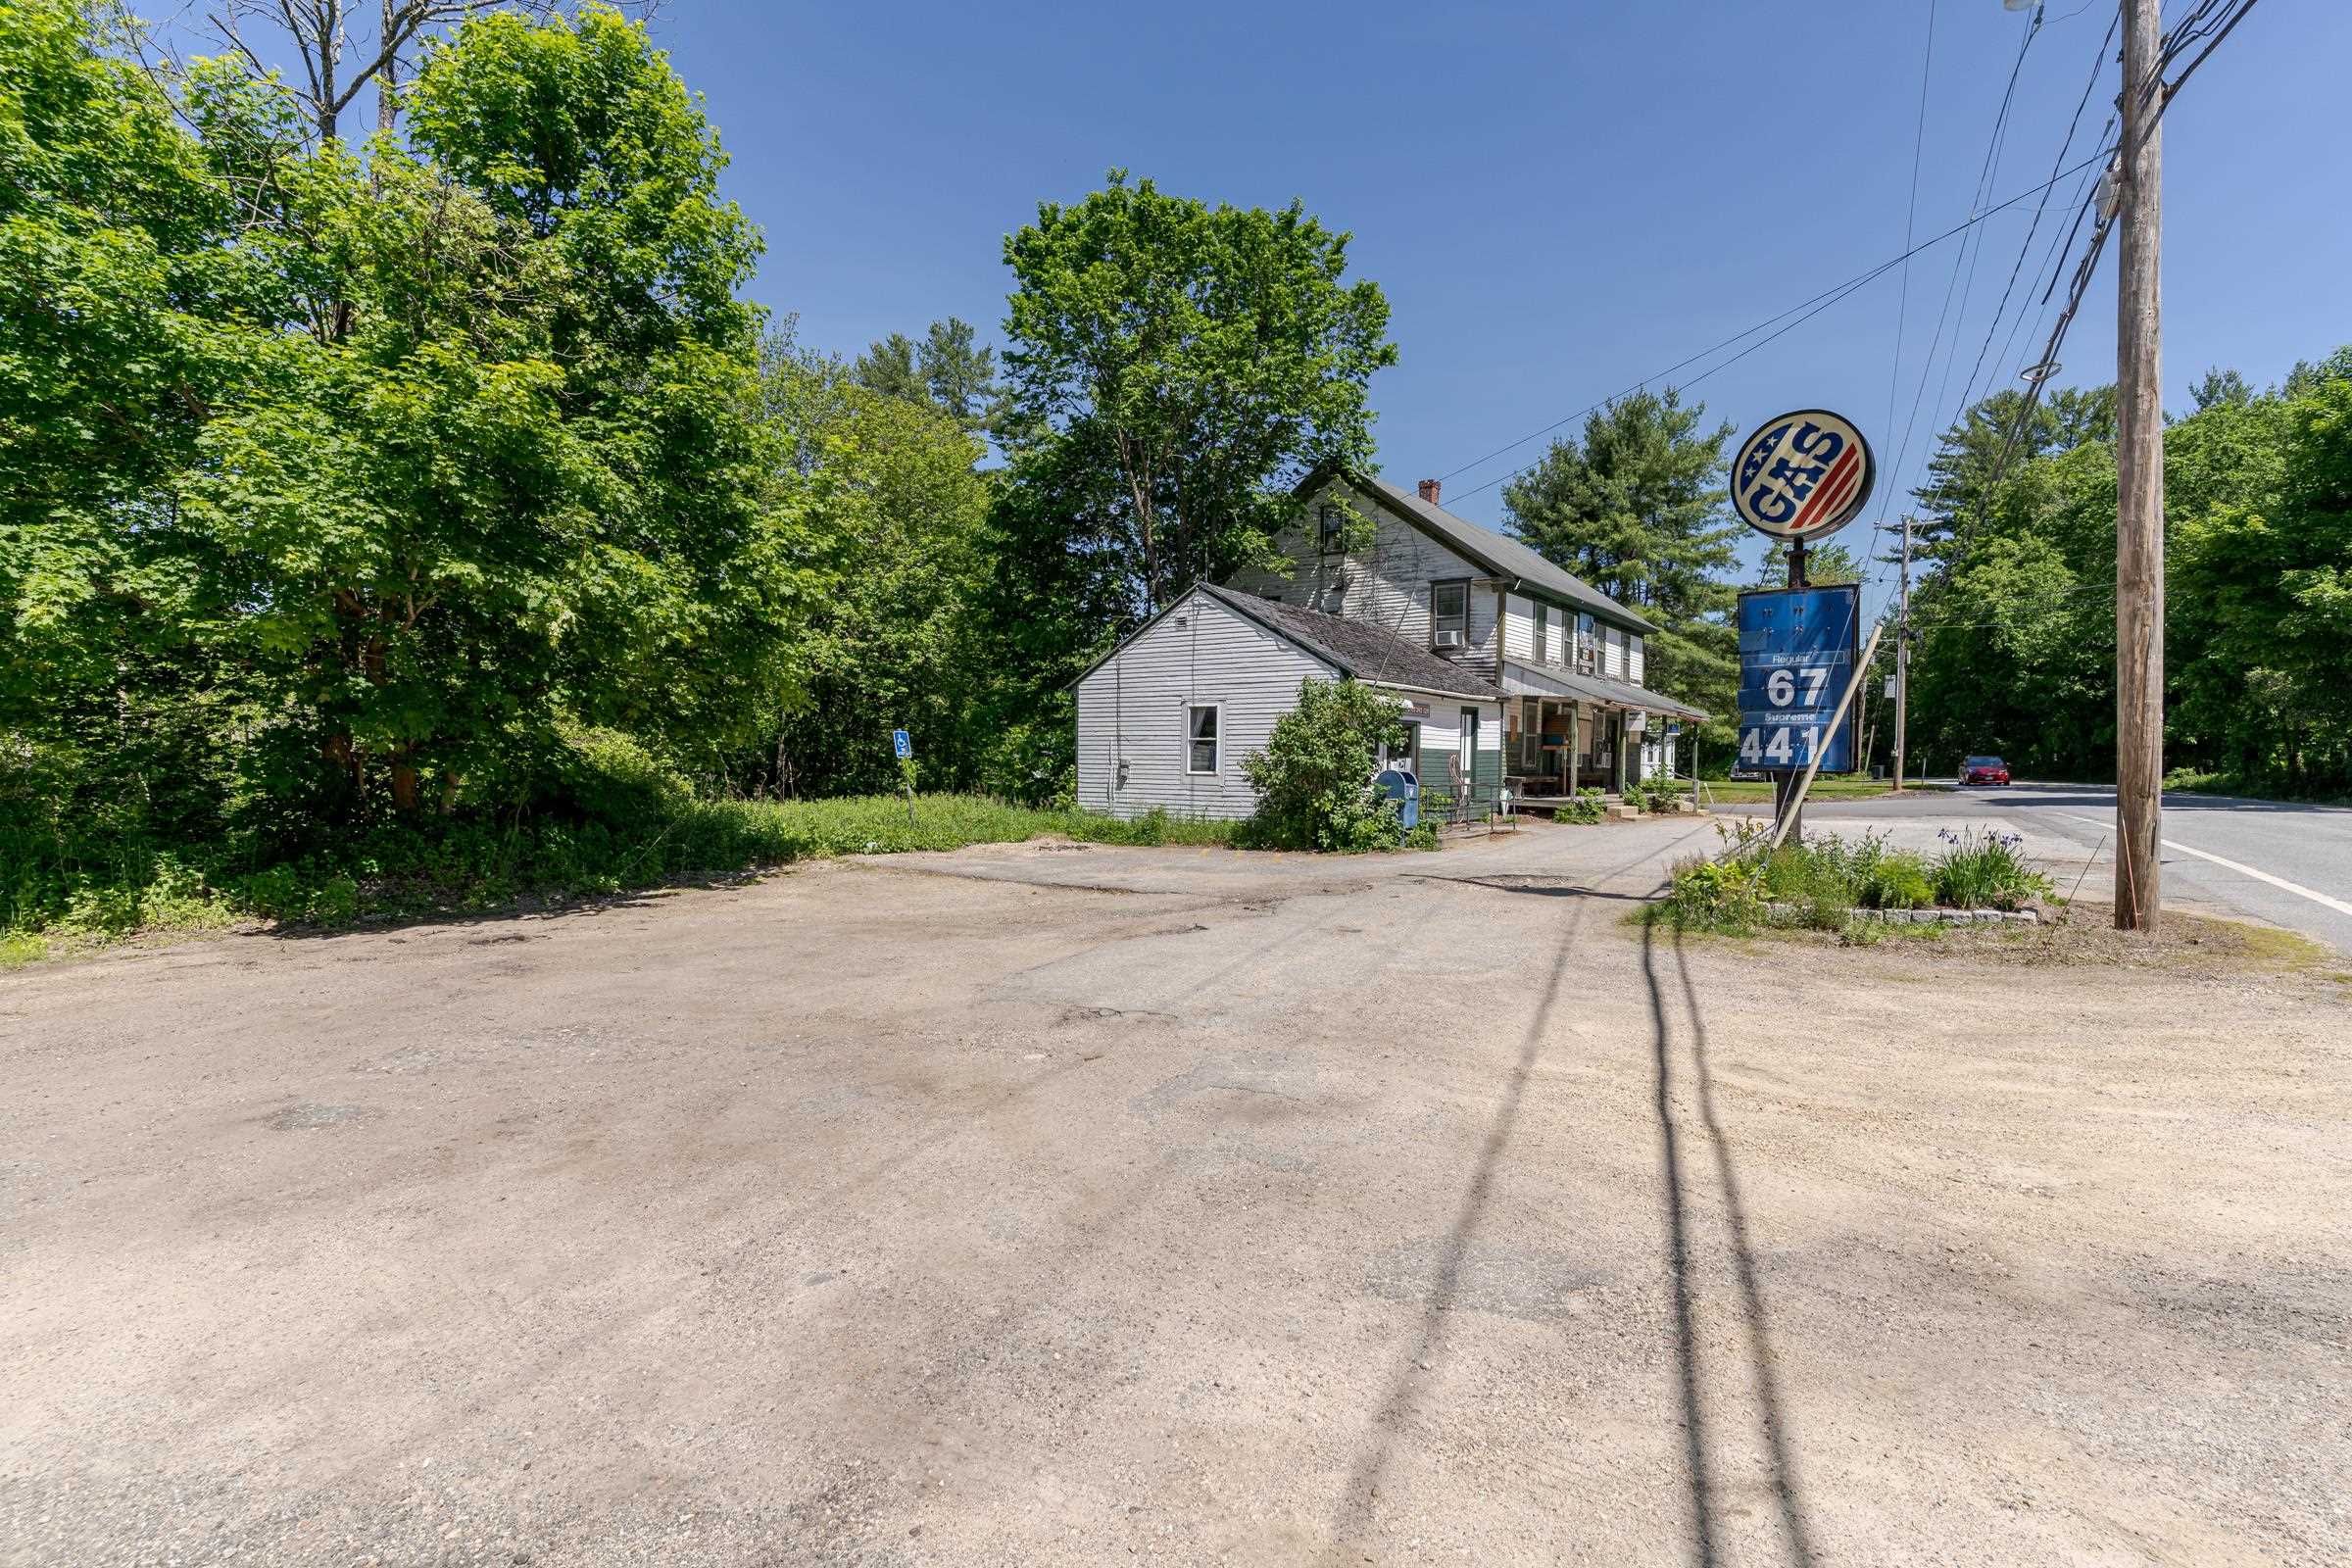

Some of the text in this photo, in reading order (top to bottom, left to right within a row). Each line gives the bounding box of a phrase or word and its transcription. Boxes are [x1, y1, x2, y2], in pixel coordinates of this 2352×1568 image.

[1748, 420, 1844, 524] GAS
[1772, 655, 1810, 666] Regular
[1768, 667, 1828, 707] 67
[1764, 712, 1816, 723] Supreme
[1740, 727, 1819, 765] 441
